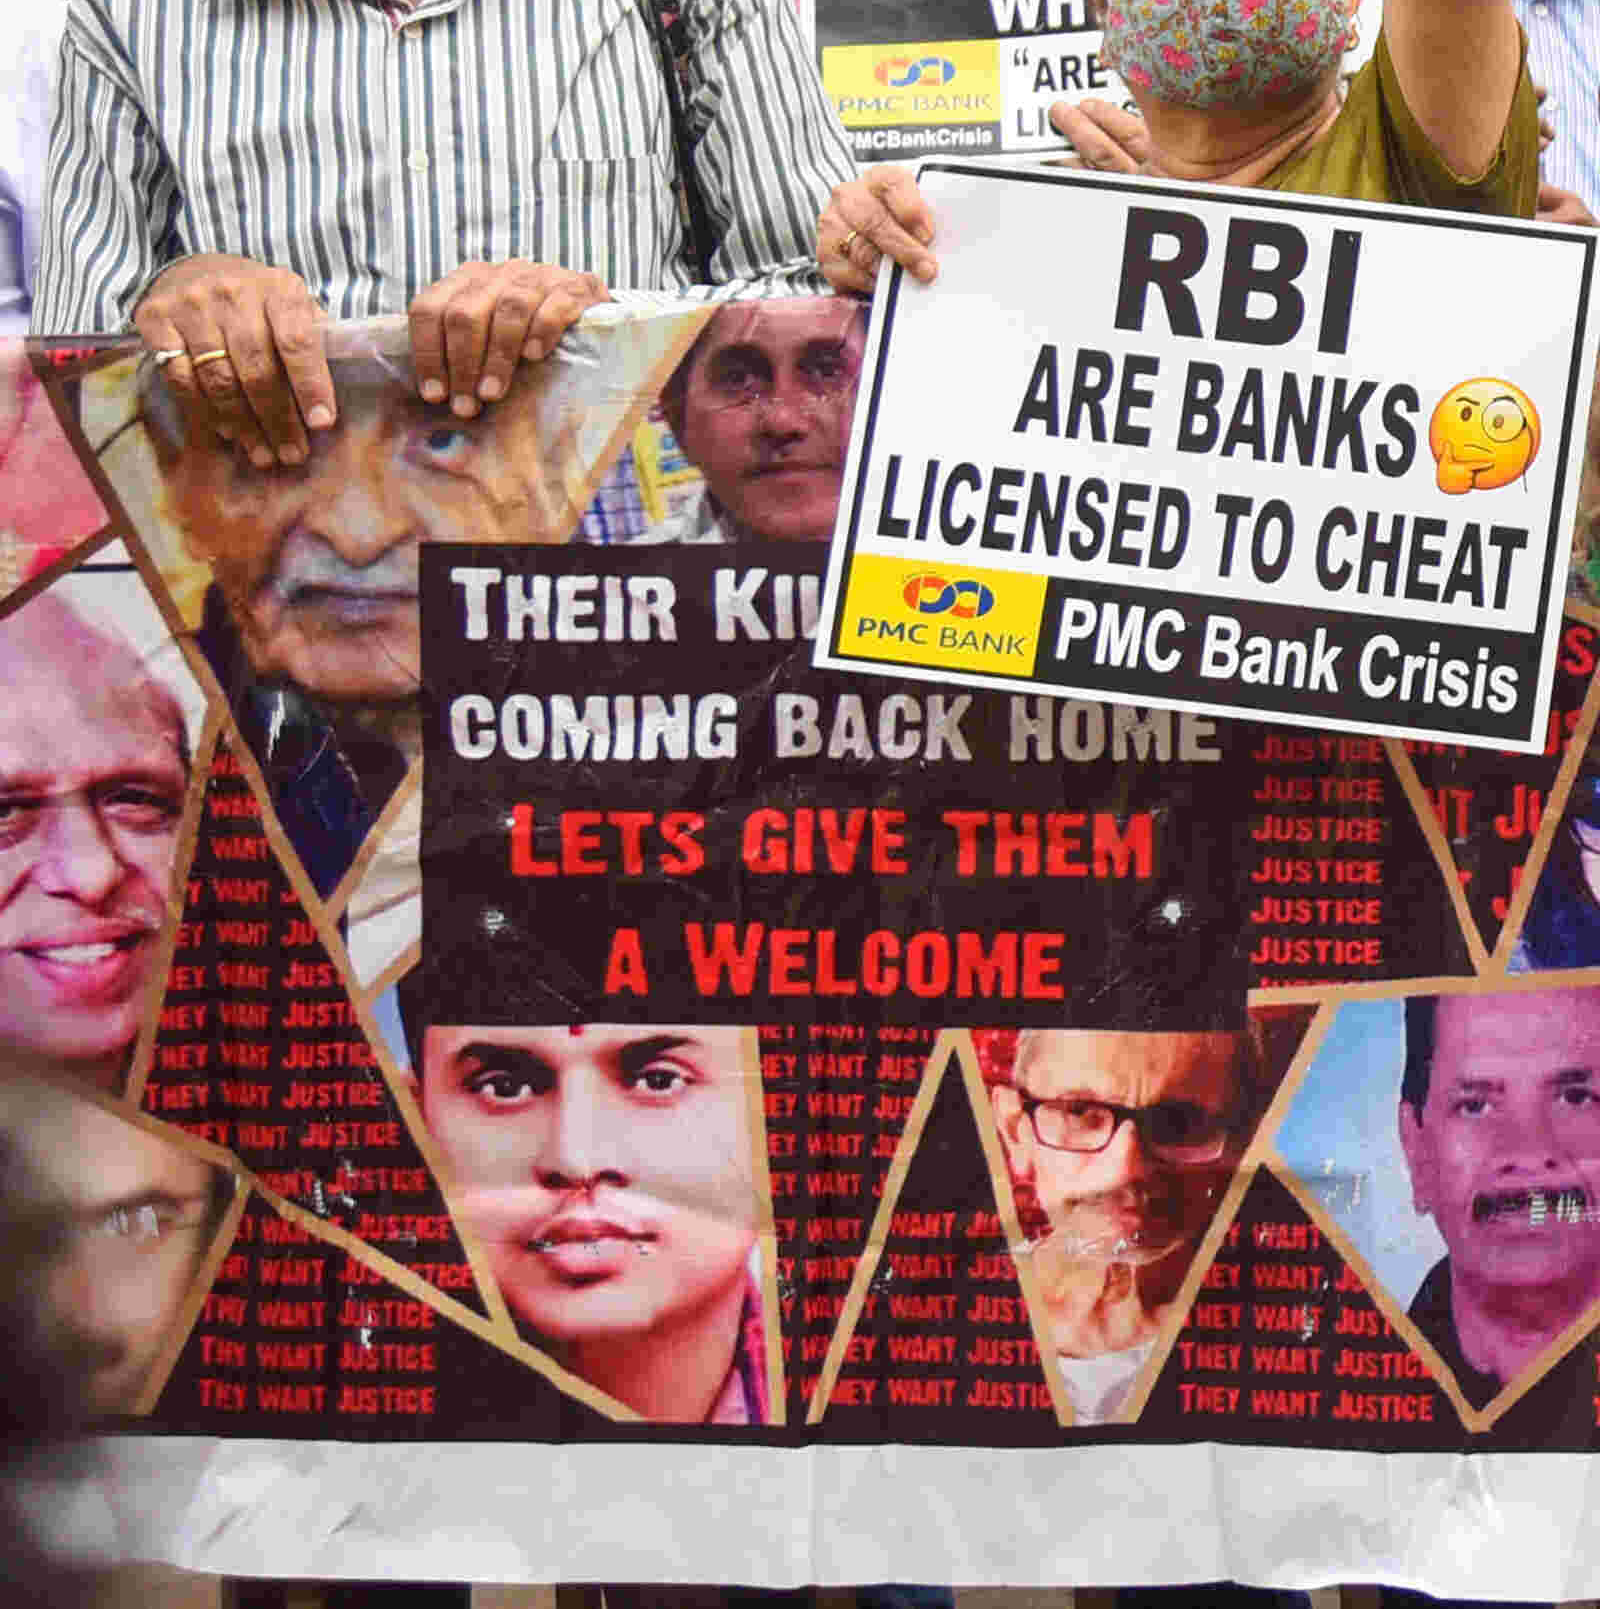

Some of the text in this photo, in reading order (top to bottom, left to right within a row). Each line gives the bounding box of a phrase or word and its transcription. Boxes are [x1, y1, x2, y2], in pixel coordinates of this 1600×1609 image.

[839, 93, 993, 116] PMC BANK
[1114, 204, 1364, 356] RBI
[1012, 343, 1421, 479] ARE BANKS
[876, 453, 1529, 612] LICENSED TO CHEAT
[856, 616, 1027, 657] PMC BANK
[1055, 599, 1187, 674] PMC
[1201, 624, 1341, 695] Bank
[1358, 639, 1520, 716] Crisis
[449, 693, 1223, 762] COMING BACK HOME
[1252, 776, 1384, 804] JUSTICE
[742, 807, 909, 876] GIVE
[942, 810, 1155, 880] THEM
[1250, 815, 1383, 844] JUSTICE
[1250, 855, 1383, 884] JUSTICE
[1249, 896, 1383, 925] JUSTICE
[604, 923, 1067, 999] A WELCOME
[1249, 936, 1384, 966] JUSTICE
[808, 1054, 867, 1080] WANT
[807, 1092, 866, 1119] WANT
[1178, 1341, 1321, 1375] THEY WANT
[1178, 1383, 1435, 1423] THEY WANT JUSTICE
